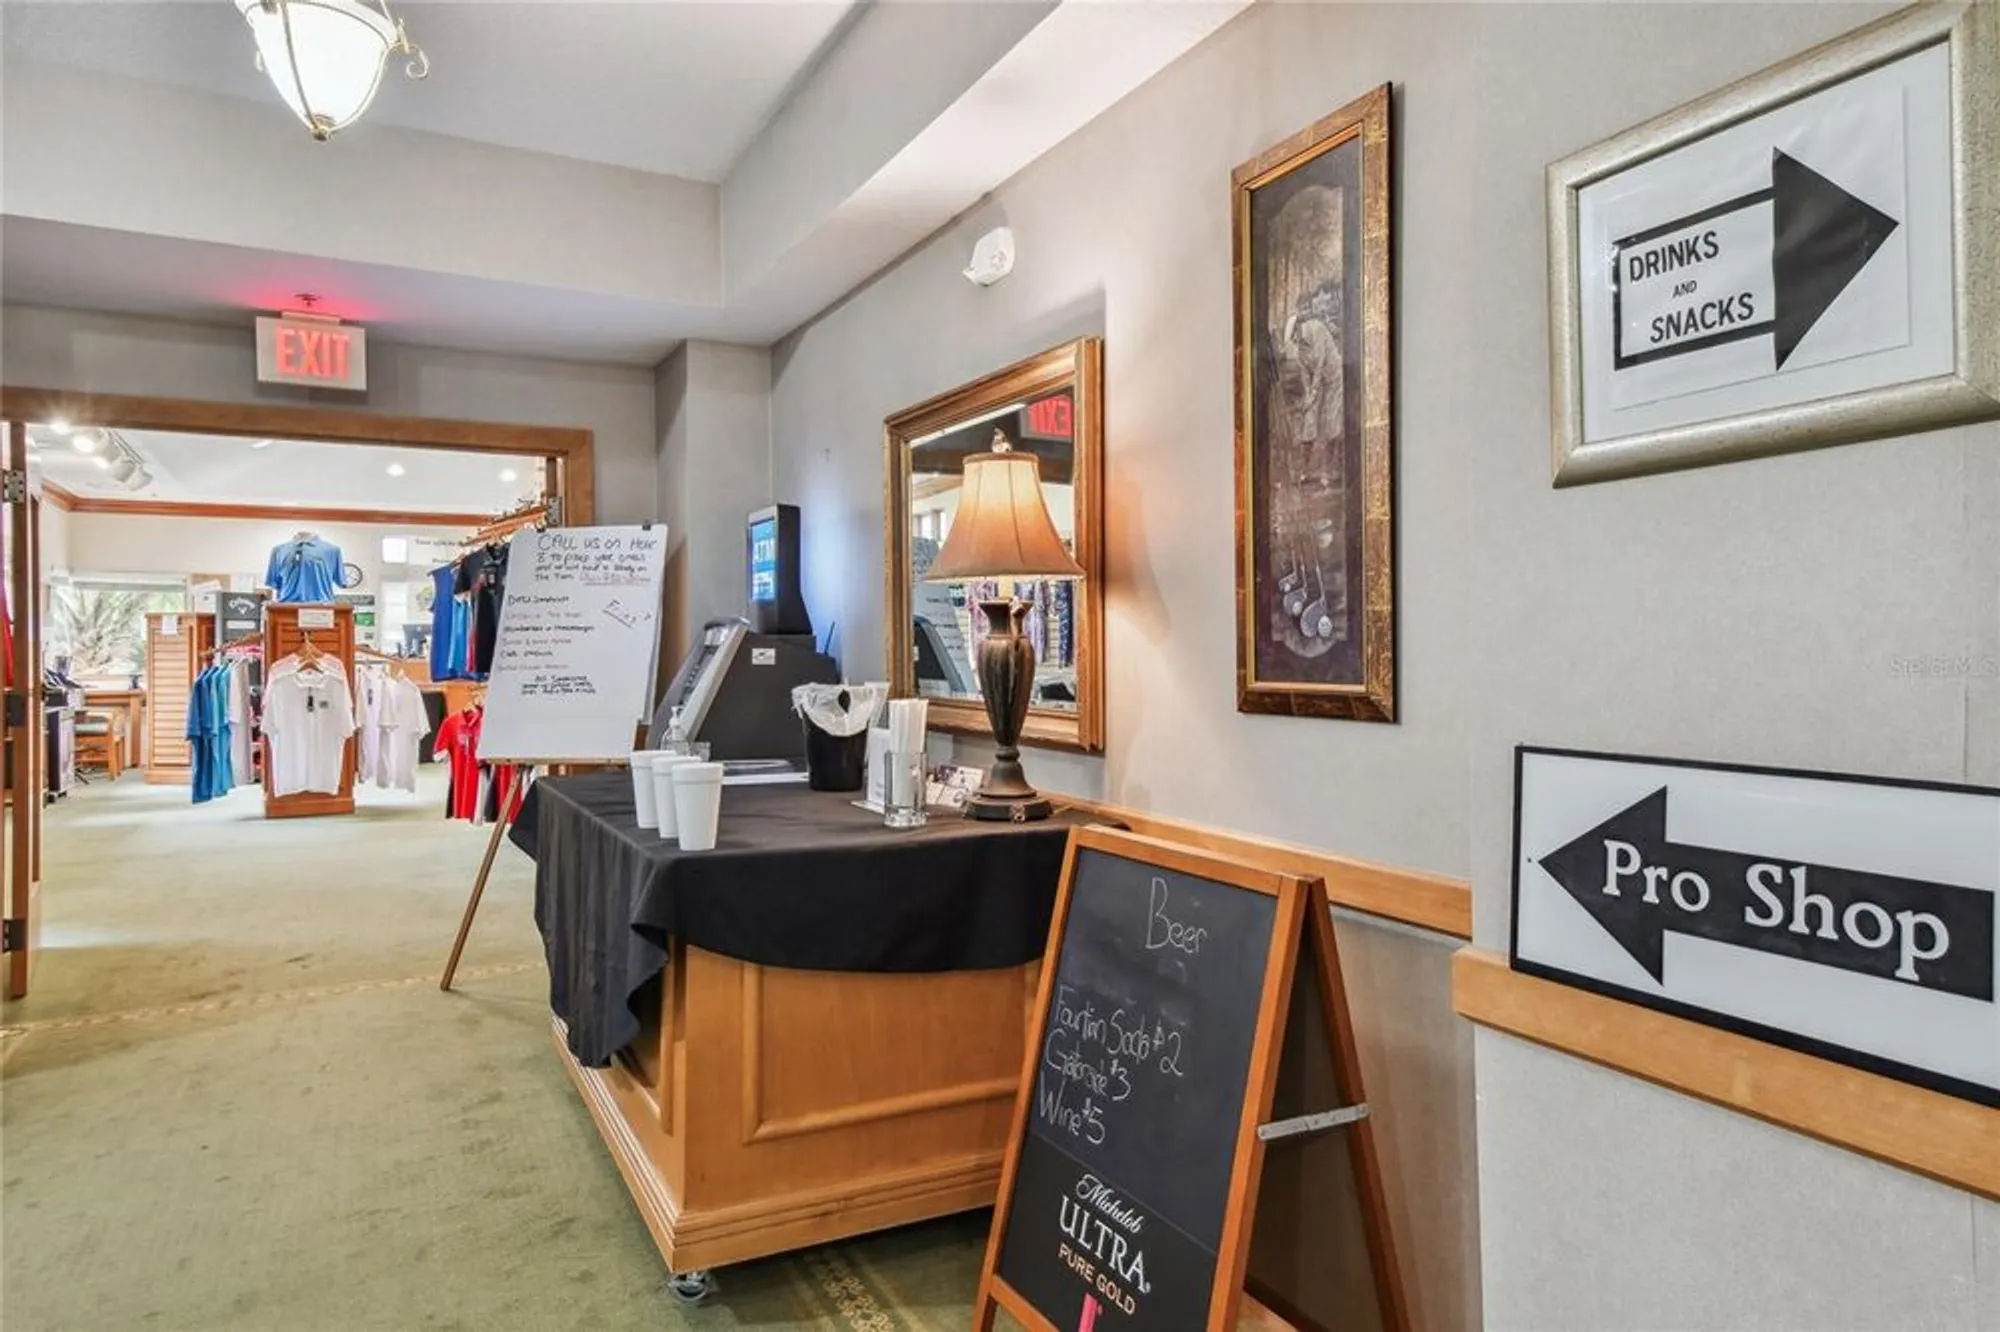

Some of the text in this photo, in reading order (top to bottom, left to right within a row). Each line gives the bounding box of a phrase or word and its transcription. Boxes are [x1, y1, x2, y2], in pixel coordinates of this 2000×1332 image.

[1629, 230, 1719, 283] DRINKS
[1650, 292, 1754, 343] SNACKS
[1672, 280, 1697, 299] AND
[276, 328, 350, 382] EXIT
[1145, 876, 1208, 956] Beer
[1602, 838, 1950, 982] Pro Shop
[1040, 1070, 1081, 1136] Wine
[1075, 1173, 1144, 1234] Michelob
[1059, 1194, 1149, 1293] ULTRA
[1058, 1242, 1136, 1316] PURE GOLD
